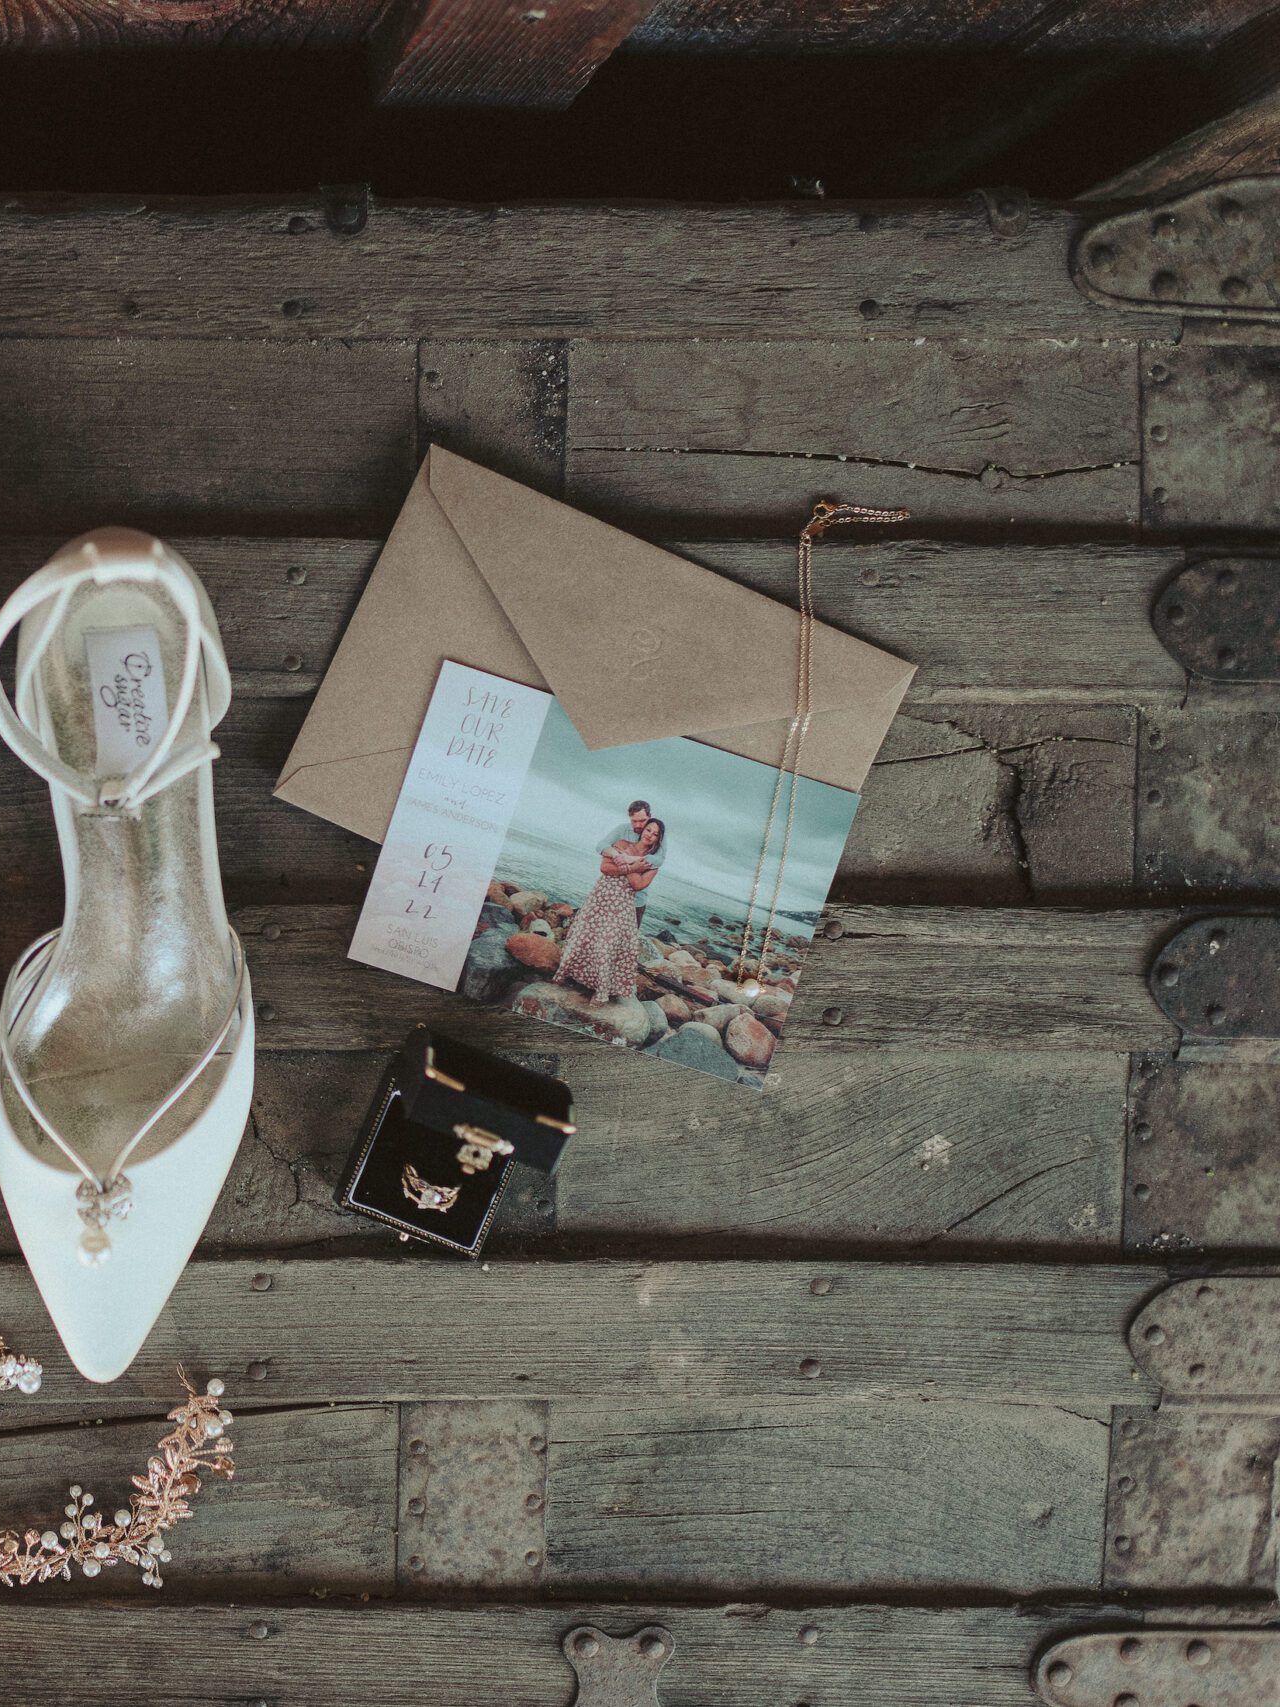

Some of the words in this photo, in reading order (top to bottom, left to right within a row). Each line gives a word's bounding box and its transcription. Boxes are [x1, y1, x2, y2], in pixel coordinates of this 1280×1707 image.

[99, 673, 131, 732] sugar
[123, 651, 152, 748] Creative
[460, 713, 504, 743] OUR
[447, 735, 496, 768] DATE
[418, 767, 460, 788] EMILY
[463, 784, 506, 805] LOPEZ
[405, 900, 439, 919] 22
